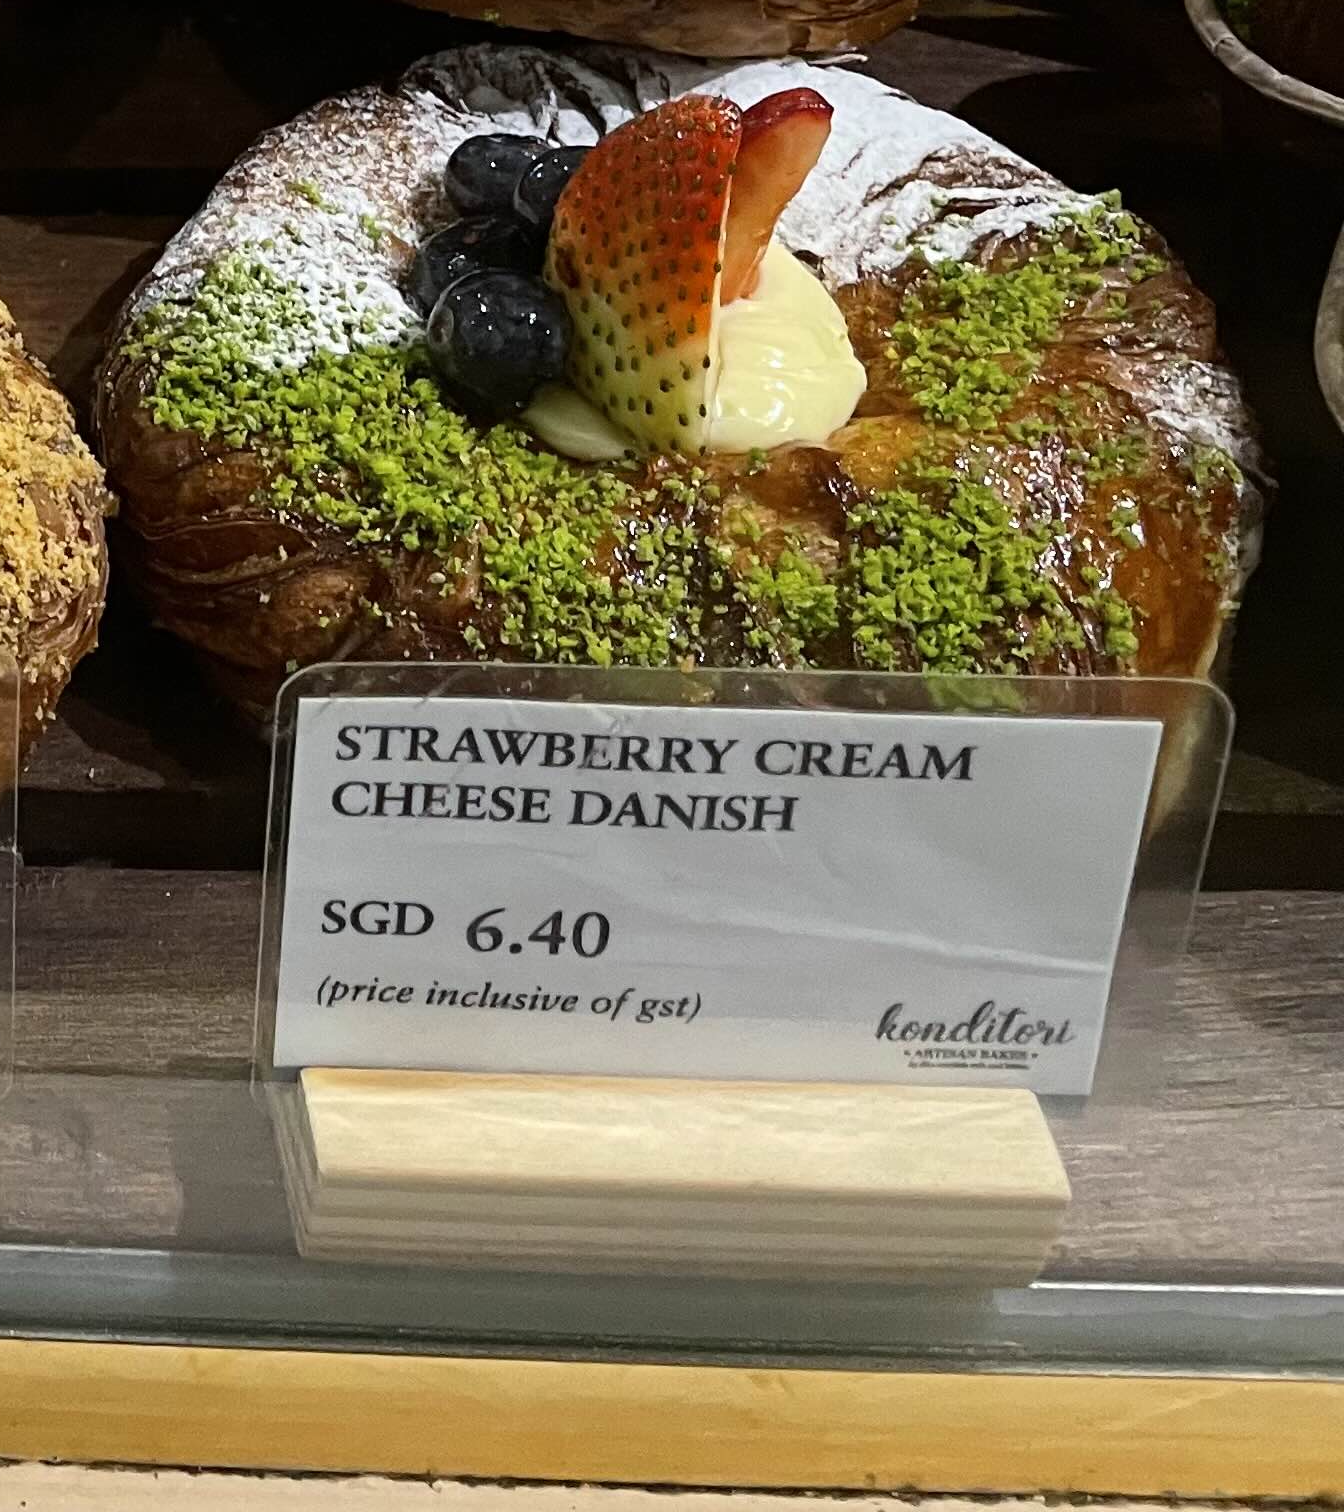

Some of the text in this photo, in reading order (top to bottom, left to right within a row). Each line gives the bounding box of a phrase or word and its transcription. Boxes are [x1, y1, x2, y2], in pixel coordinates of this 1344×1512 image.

[334, 724, 979, 783] STRAWBERRY CREAM
[330, 780, 798, 833] CHEESE DANISH
[321, 899, 611, 959] SGD 6.40
[316, 974, 702, 1025] (price inclusive of gst)
[875, 1000, 1077, 1046] konditori
